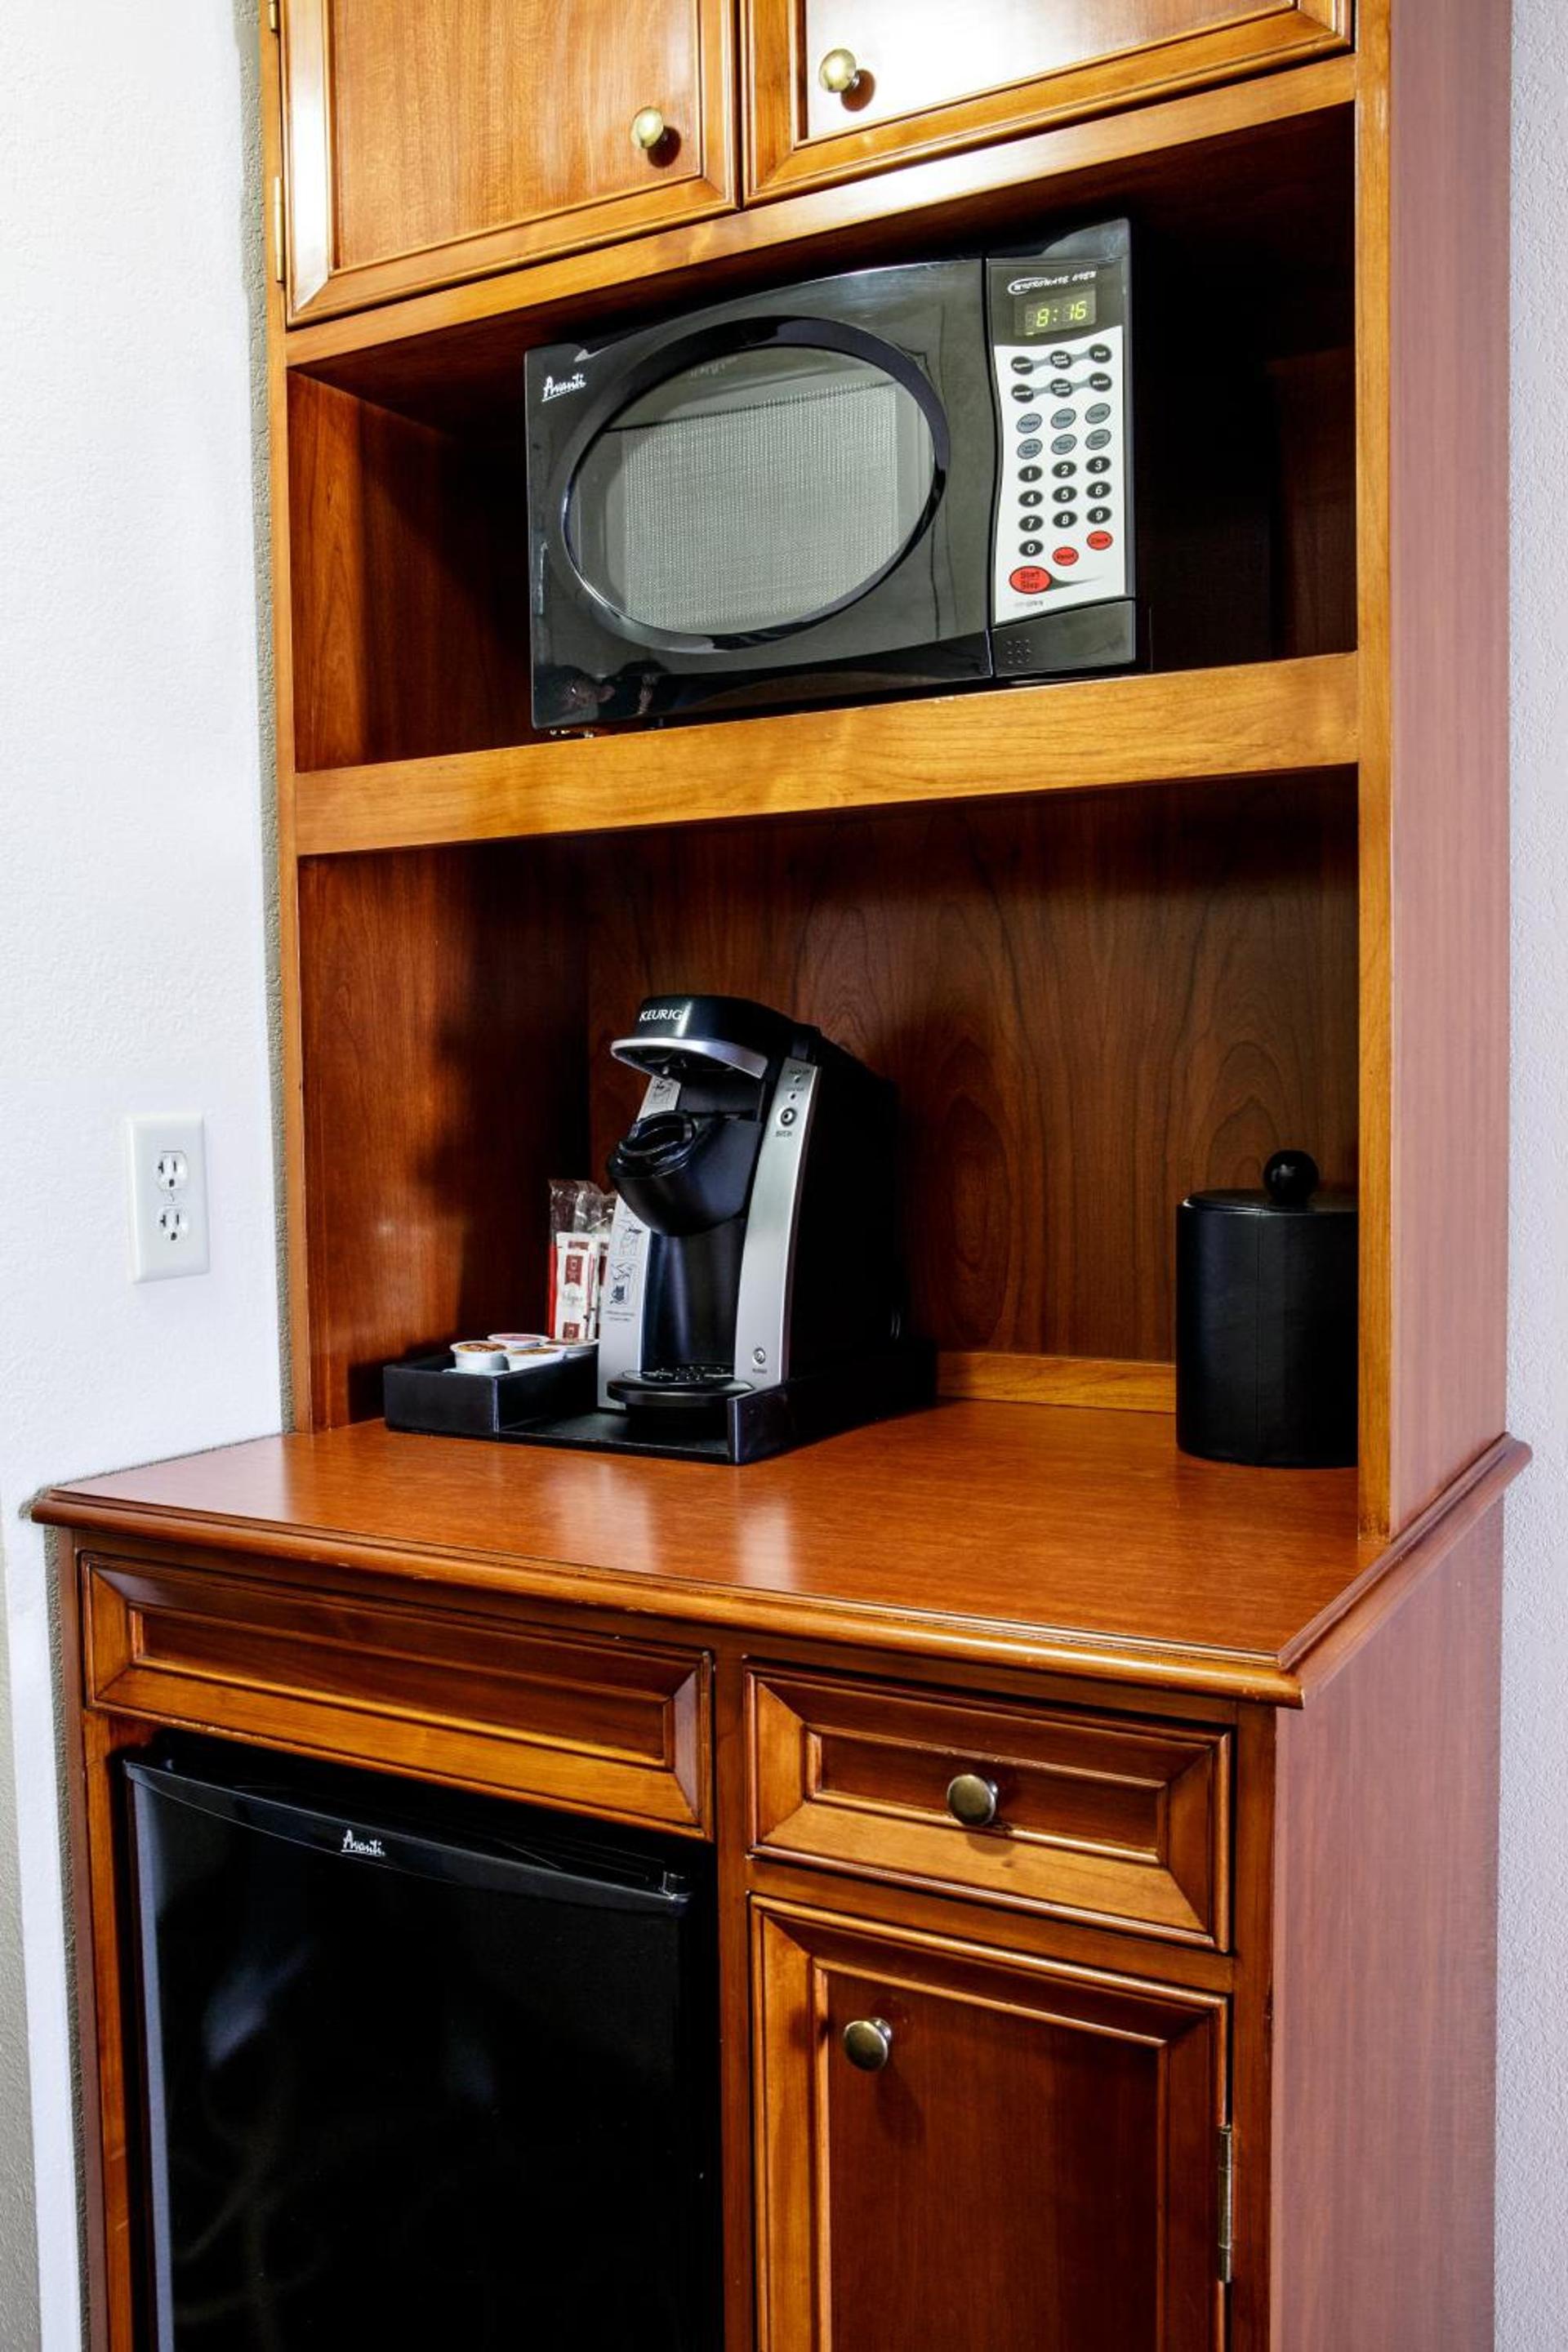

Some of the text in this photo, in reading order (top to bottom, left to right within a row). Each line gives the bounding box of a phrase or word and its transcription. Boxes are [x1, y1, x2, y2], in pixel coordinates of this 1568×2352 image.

[1036, 301, 1087, 327] 8:16
[542, 372, 587, 402] Avanti
[1061, 465, 1069, 475] 2
[1094, 460, 1102, 470] 3
[1062, 490, 1069, 500] 5
[1095, 485, 1103, 495] 6
[1027, 493, 1035, 503] 4
[1062, 514, 1069, 524] 8
[1095, 510, 1103, 520] 9
[1028, 519, 1036, 529] 7
[1027, 543, 1036, 554] 0
[639, 1009, 683, 1022] KEURIG
[341, 1829, 385, 1857] Avanti
